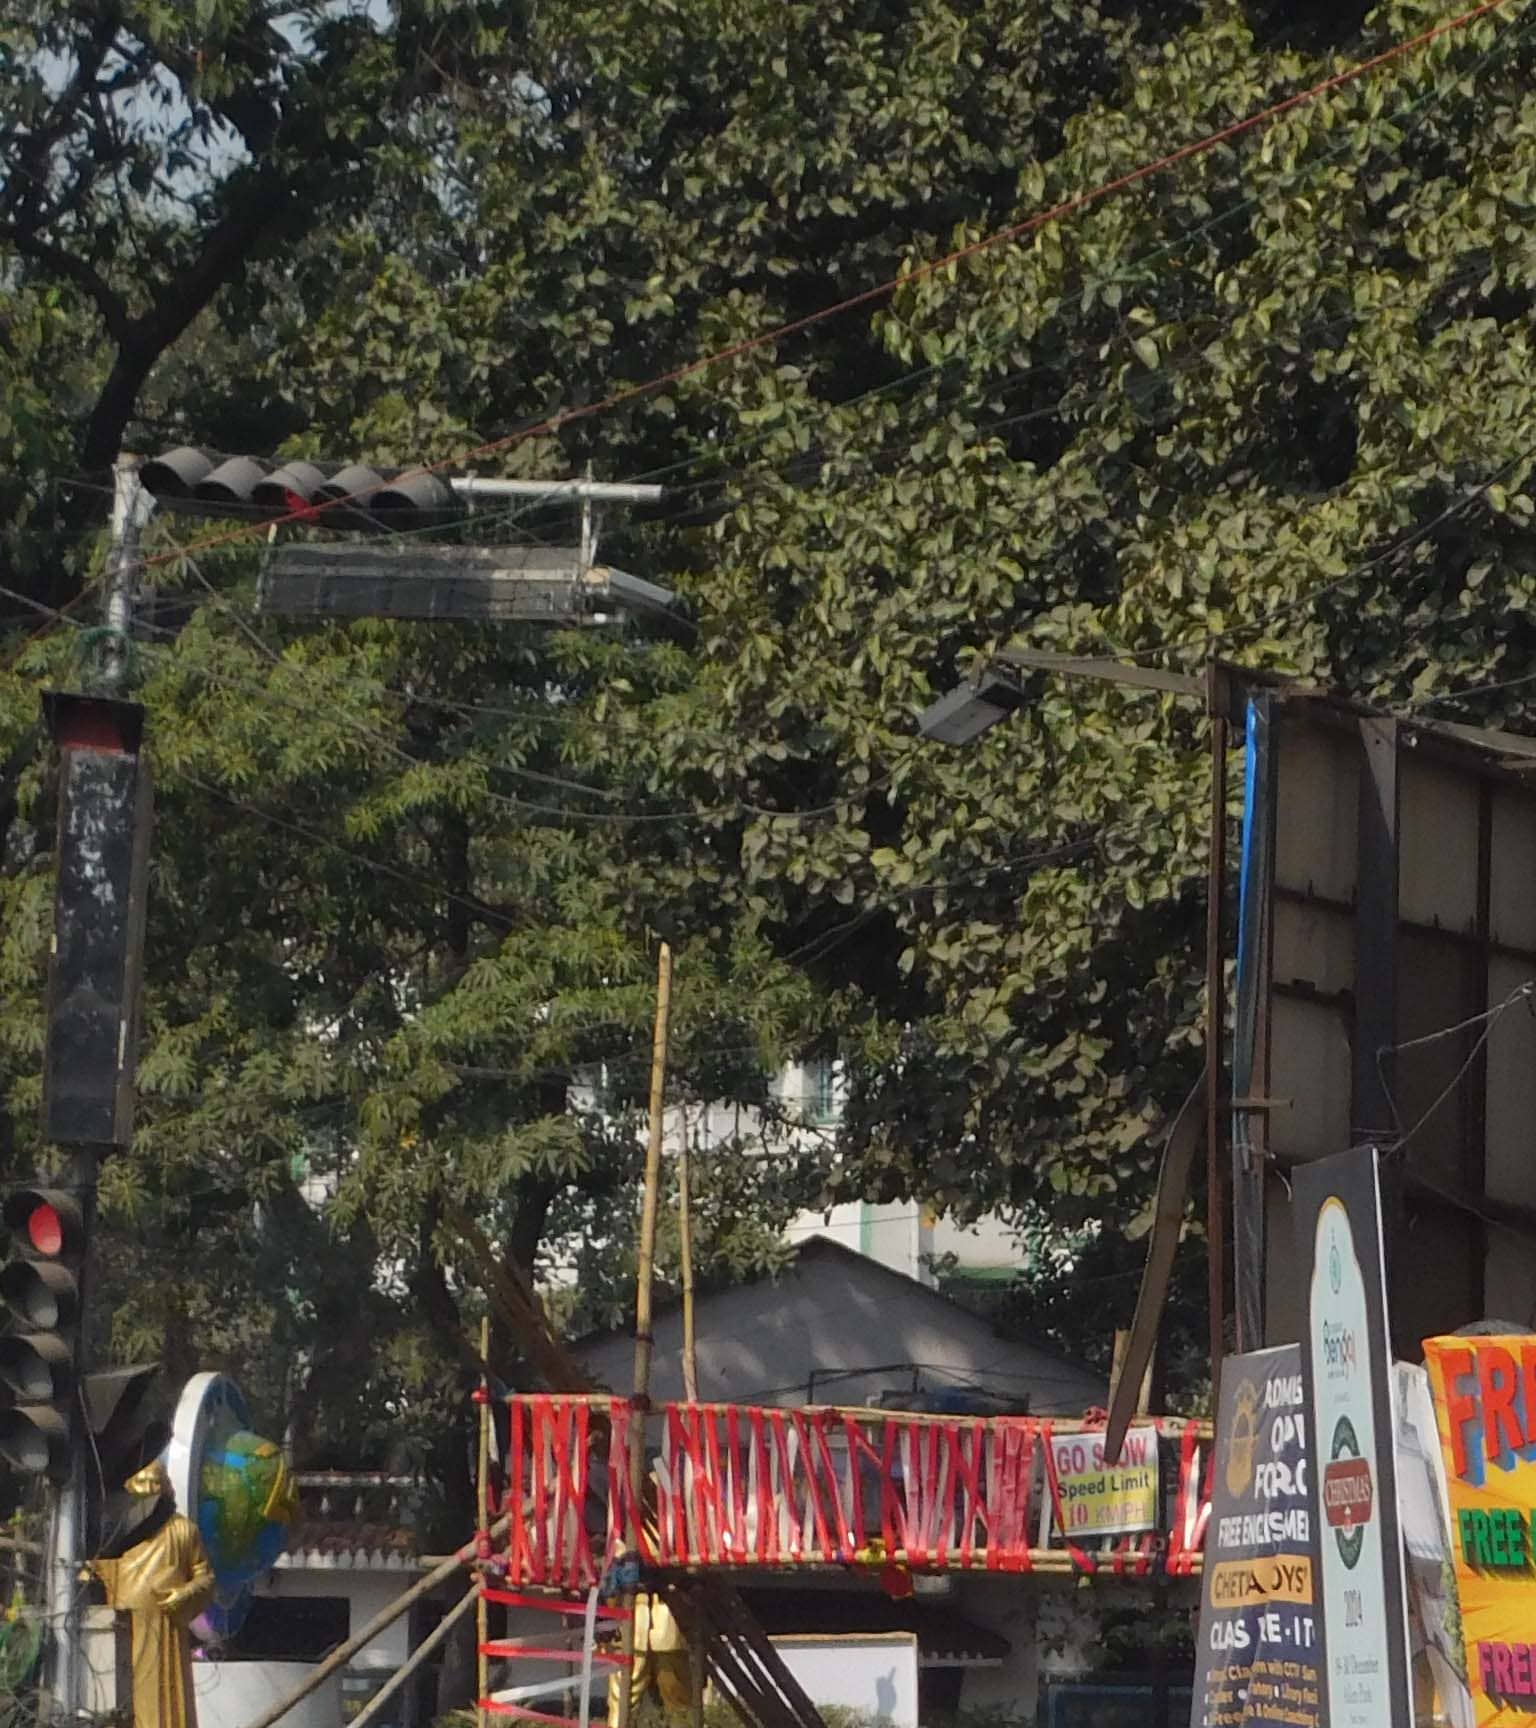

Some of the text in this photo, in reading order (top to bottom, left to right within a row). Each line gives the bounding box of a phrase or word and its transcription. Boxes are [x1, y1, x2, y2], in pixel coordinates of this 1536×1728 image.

[1057, 1437, 1147, 1476] GO SOW
[1058, 1471, 1149, 1499] Speed Limit
[1326, 1475, 1370, 1506] CHRISTMAS
[1070, 1503, 1088, 1527] 10
[1218, 1515, 1242, 1548] FREE
[1457, 1508, 1527, 1571] FREE
[1215, 1565, 1308, 1599] CHETA OYS'
